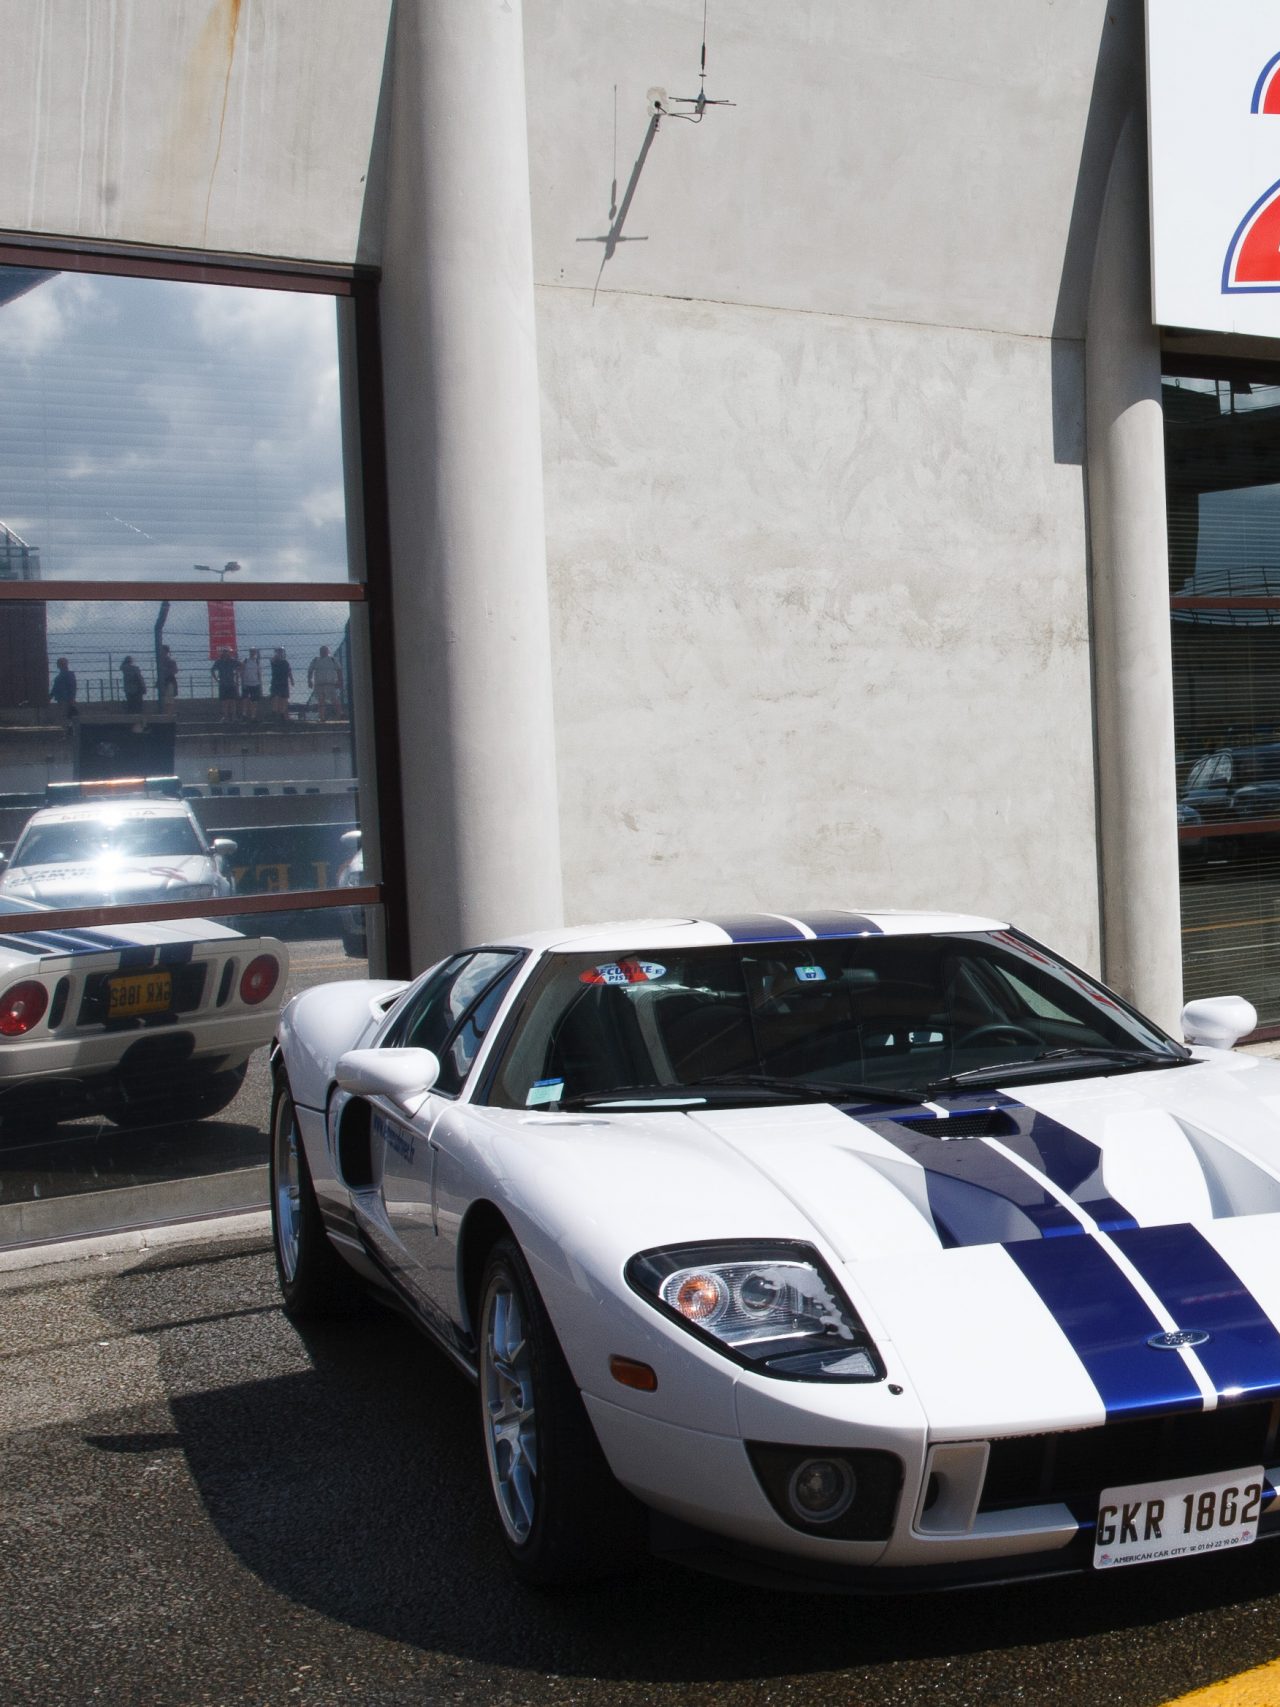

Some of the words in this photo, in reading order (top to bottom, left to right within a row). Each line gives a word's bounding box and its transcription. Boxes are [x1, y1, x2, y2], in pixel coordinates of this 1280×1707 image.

[1097, 1500, 1165, 1546] GKR
[1183, 1484, 1262, 1534] 1862
[1113, 1553, 1152, 1564] AMERICAN
[1154, 1550, 1169, 1558] CAR
[1171, 1547, 1187, 1556] CITY
